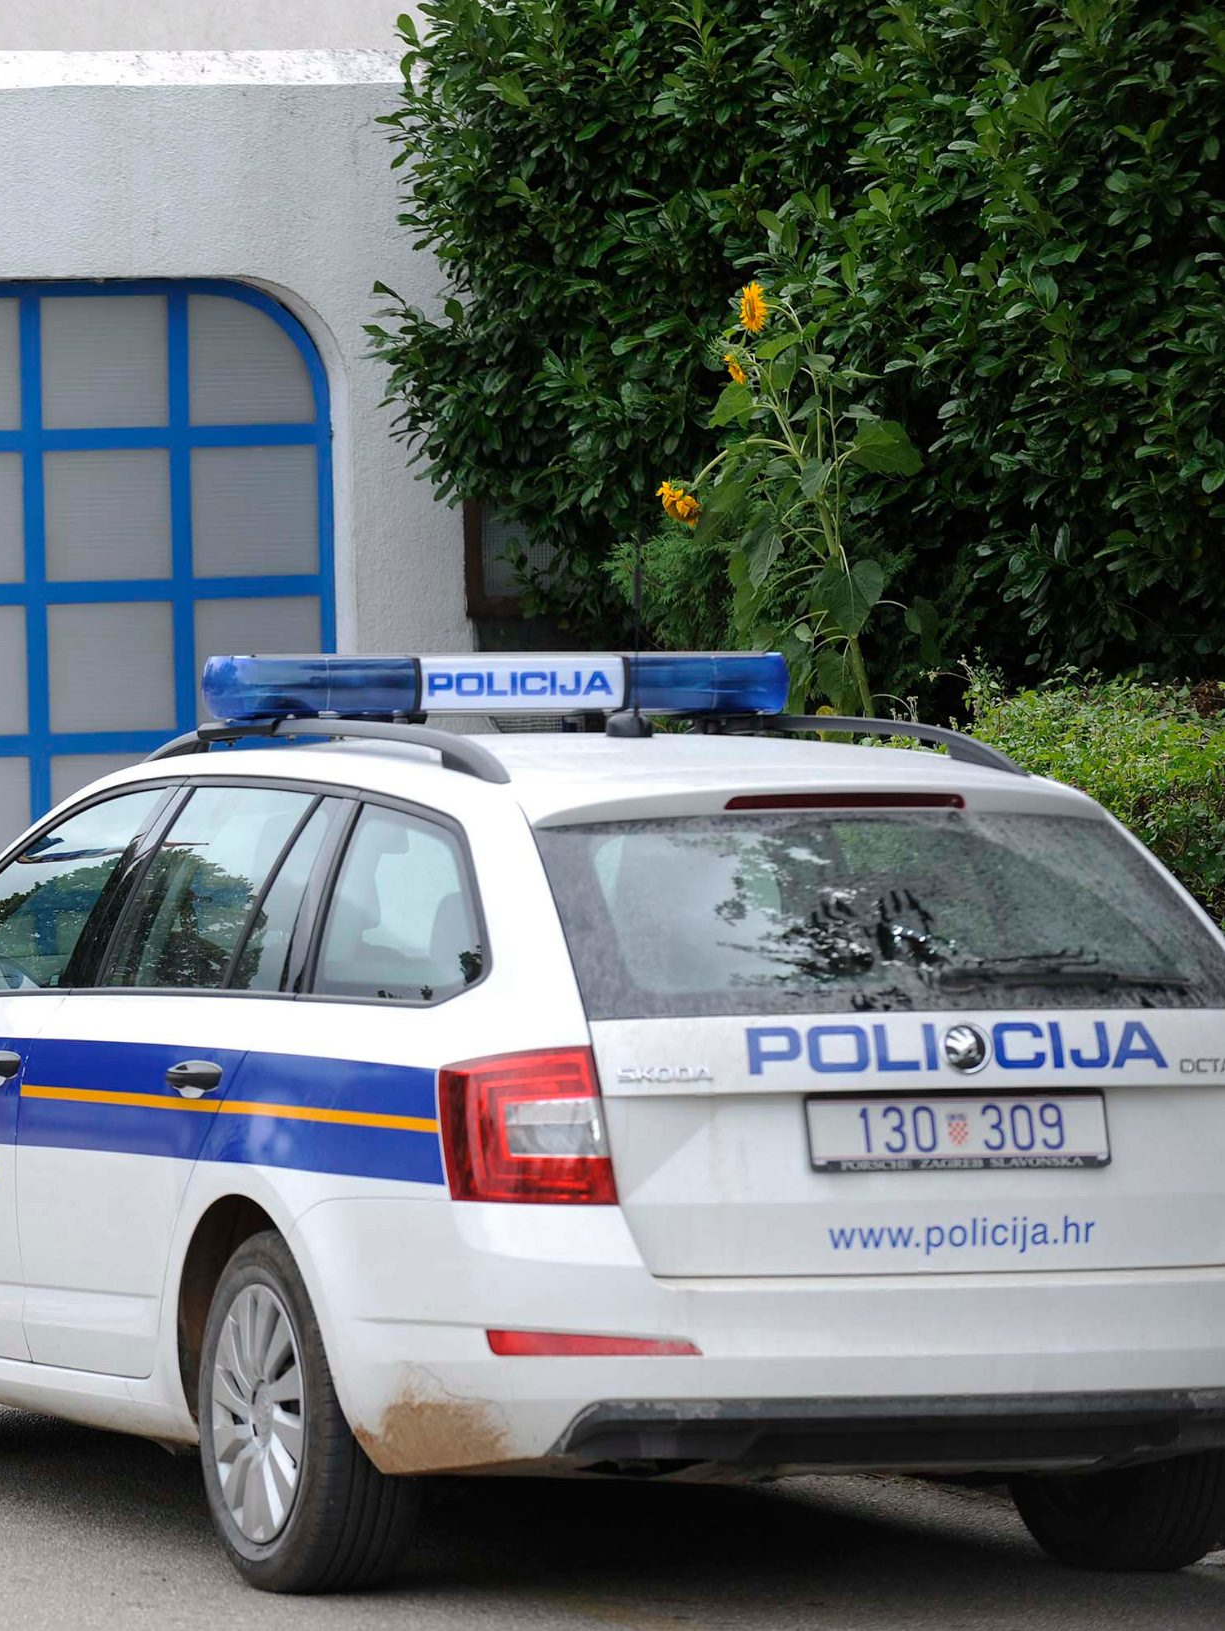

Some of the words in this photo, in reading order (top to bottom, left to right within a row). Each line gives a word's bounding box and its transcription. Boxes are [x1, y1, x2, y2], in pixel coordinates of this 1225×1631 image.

[428, 671, 613, 696] POLICIJA
[859, 1106, 937, 1153] 130
[981, 1103, 1065, 1151] 309
[828, 1215, 1095, 1255] www.policija.hr
